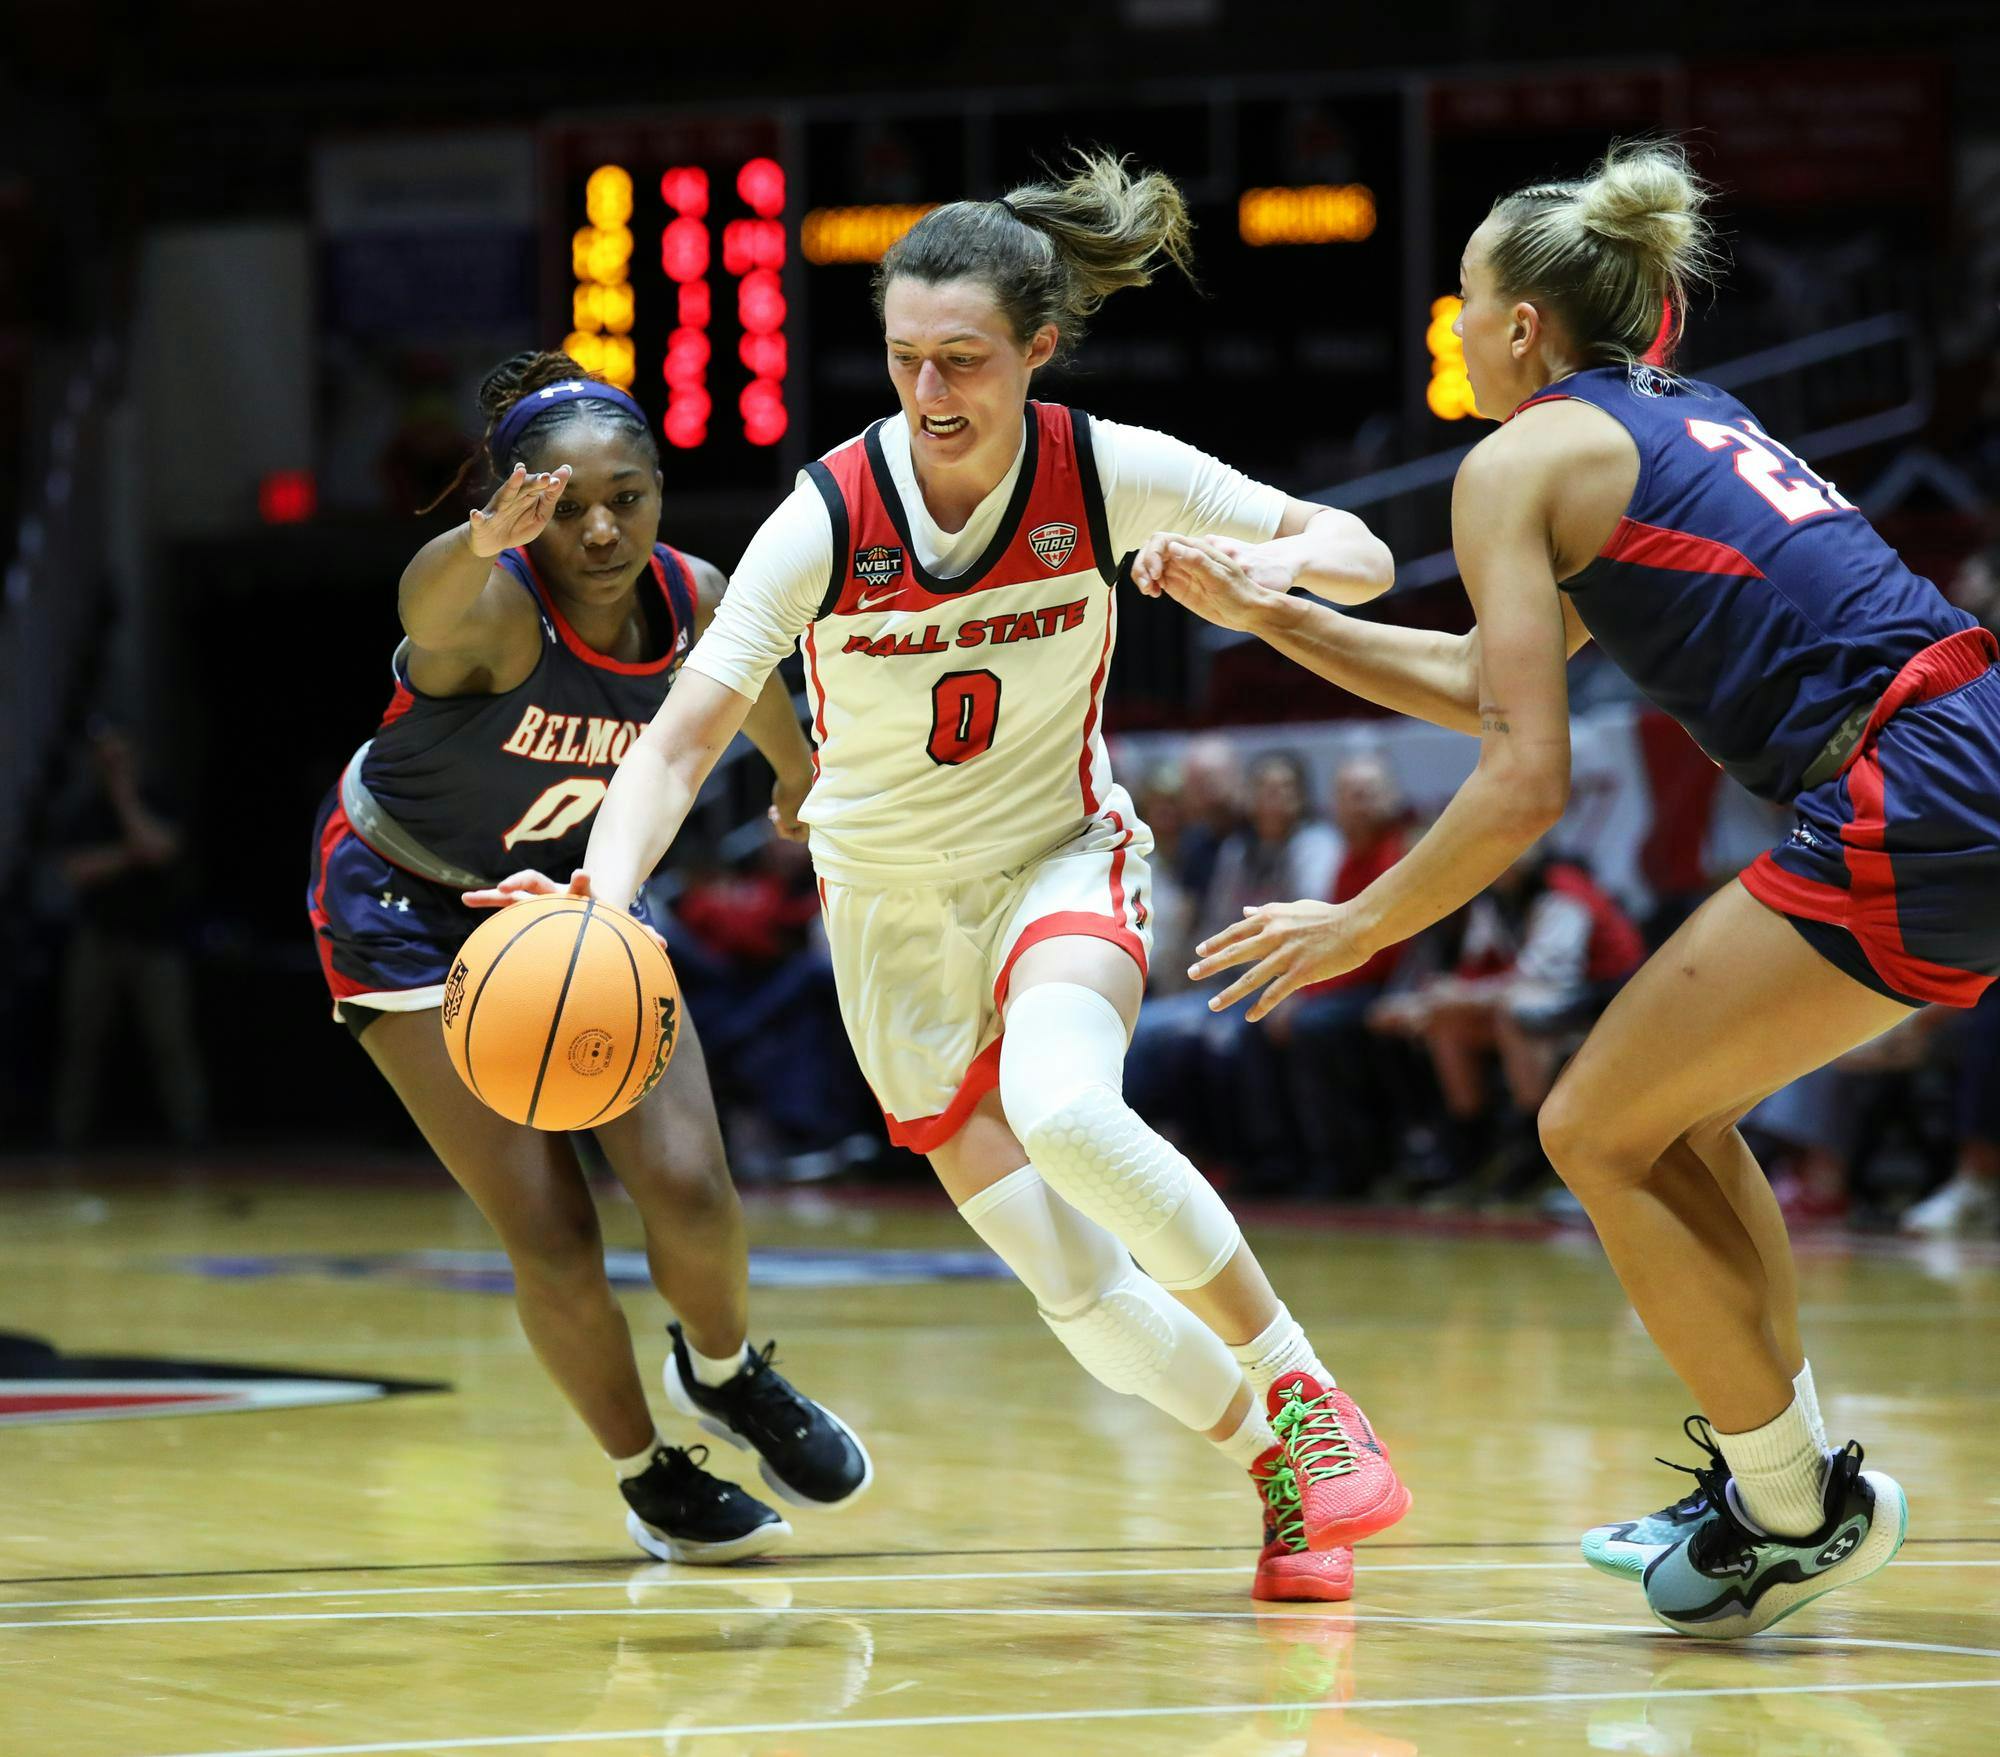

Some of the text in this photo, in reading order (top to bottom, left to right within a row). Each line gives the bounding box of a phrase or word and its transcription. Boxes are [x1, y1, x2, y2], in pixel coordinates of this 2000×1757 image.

[856, 559, 902, 573] WBIT
[1035, 536, 1074, 552] MAC
[956, 596, 1089, 648] STATE
[500, 704, 651, 767] BELMO
[926, 668, 1002, 766] 0
[502, 776, 608, 854] 0
[628, 996, 676, 1105] NCAA
